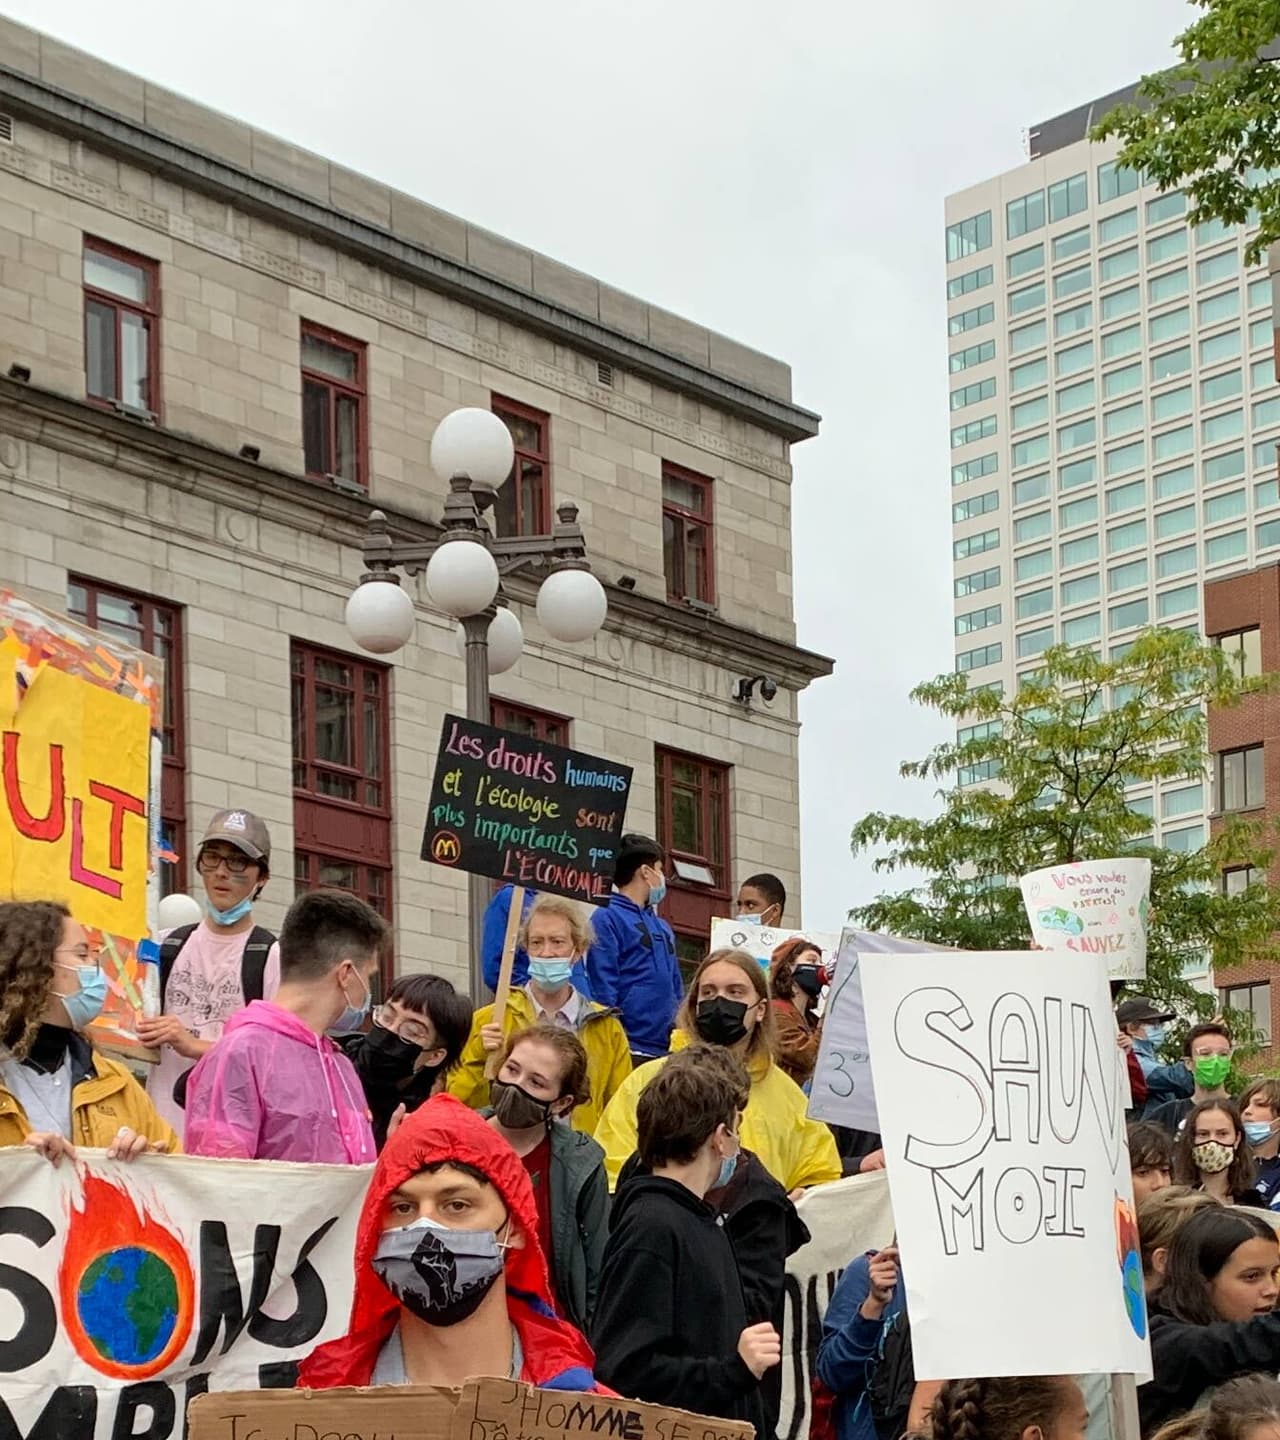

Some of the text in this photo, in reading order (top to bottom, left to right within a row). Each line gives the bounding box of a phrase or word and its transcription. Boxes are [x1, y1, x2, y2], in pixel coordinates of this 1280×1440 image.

[445, 722, 627, 792] Les droits humains
[442, 768, 463, 797] et
[575, 807, 616, 832] sont
[474, 812, 579, 859] importants
[588, 847, 613, 868] que
[930, 1165, 1086, 1257] MOI
